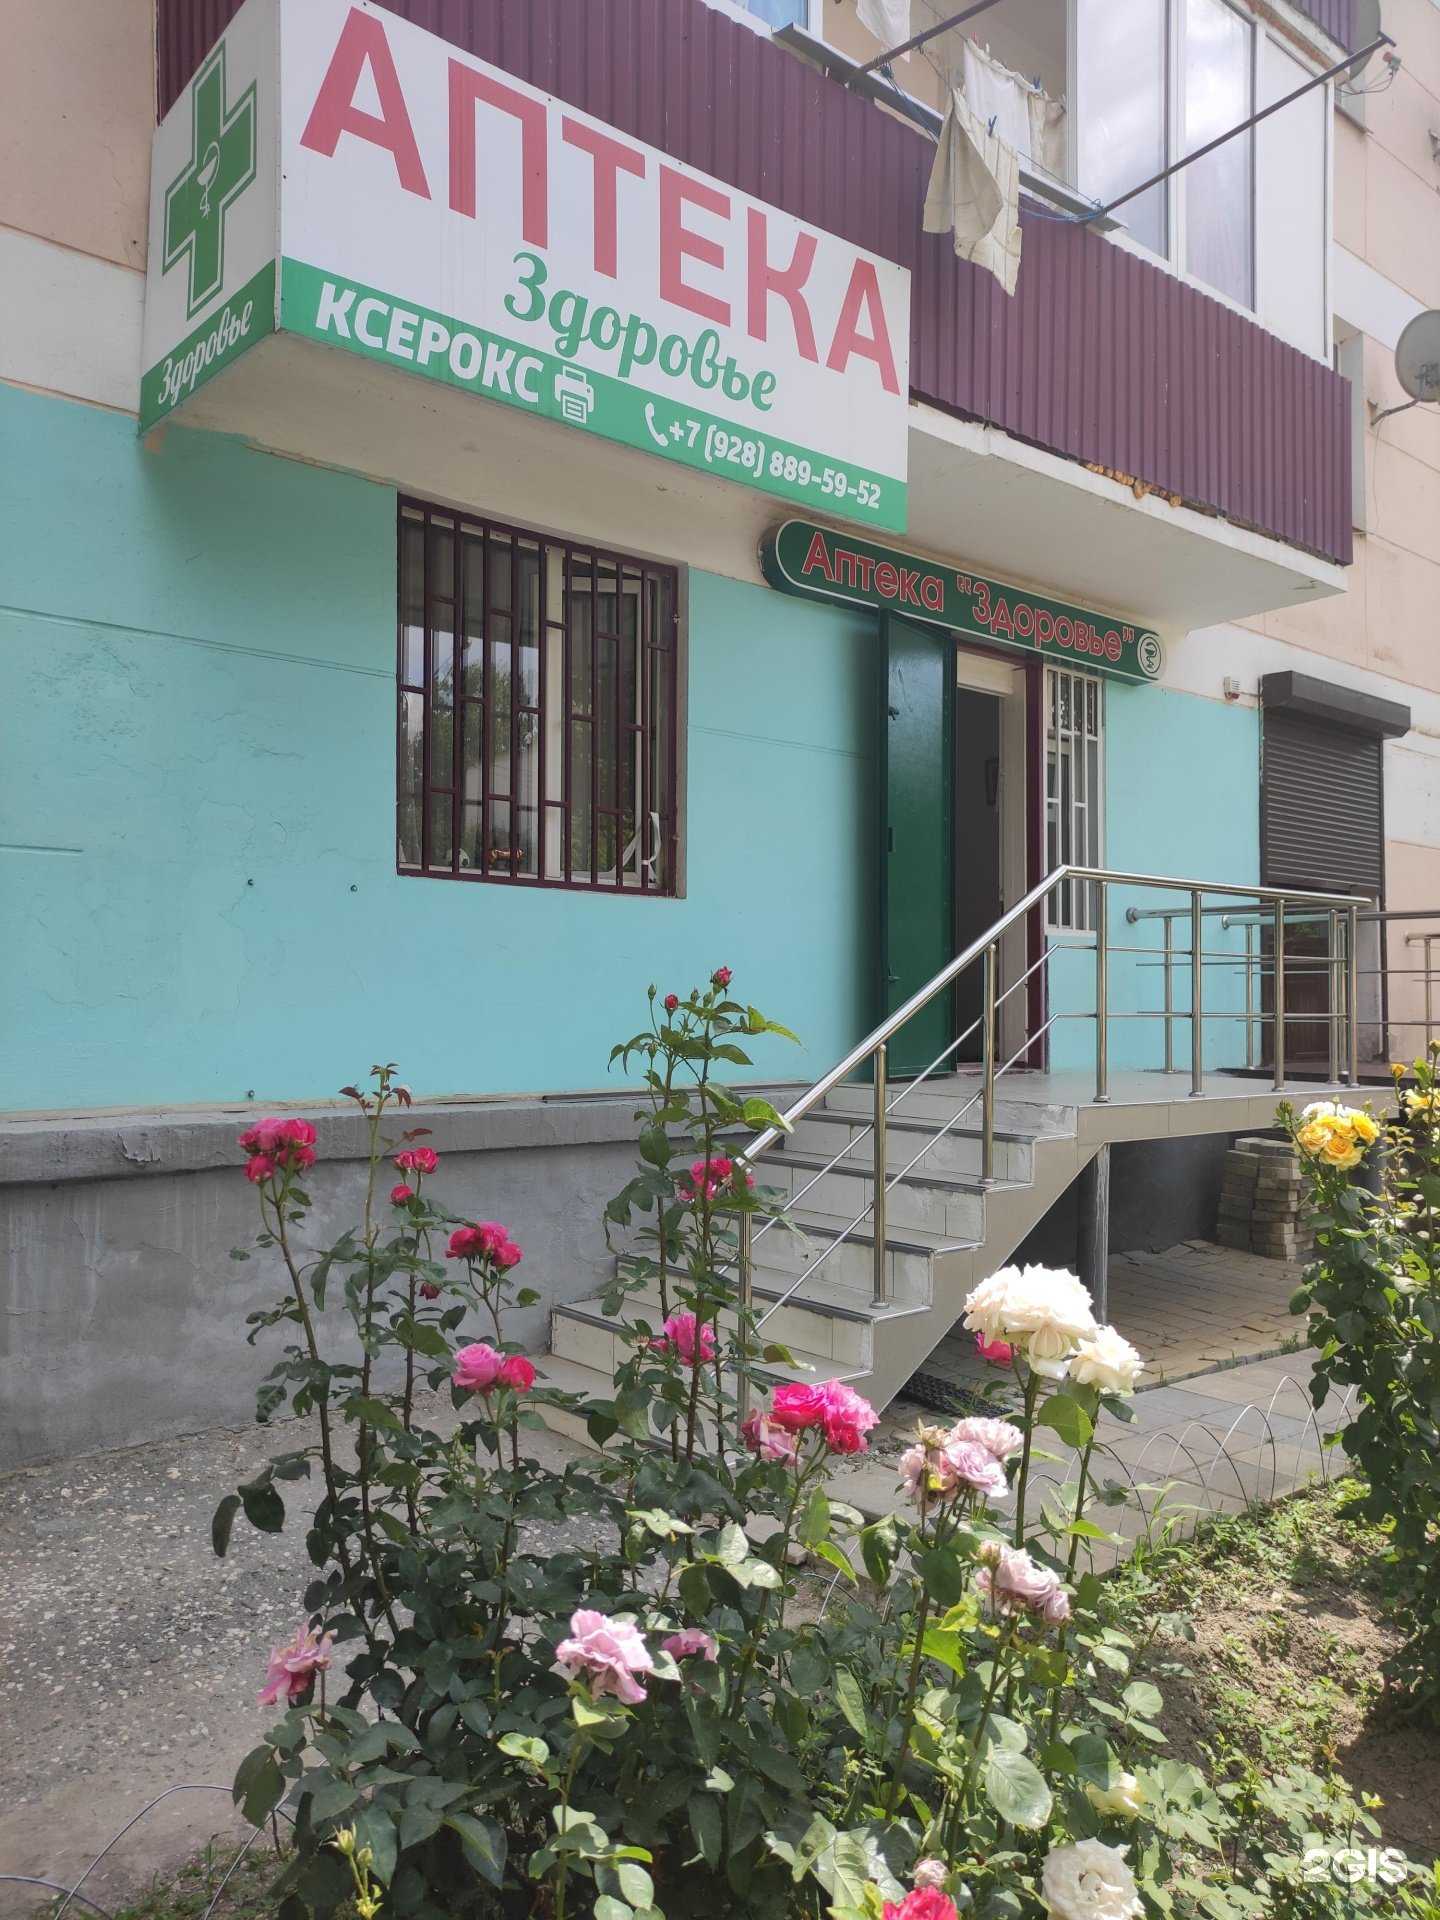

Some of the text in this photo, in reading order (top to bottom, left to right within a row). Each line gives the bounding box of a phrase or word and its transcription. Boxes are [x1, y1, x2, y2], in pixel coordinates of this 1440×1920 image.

[300, 6, 900, 396] АПТЕКА
[158, 300, 253, 406] Здоровье
[315, 281, 543, 402] КСЕРОКС
[504, 252, 776, 411] Здоровье
[669, 419, 881, 508] +7 (928) 889-59-52
[801, 531, 944, 613] Аптека
